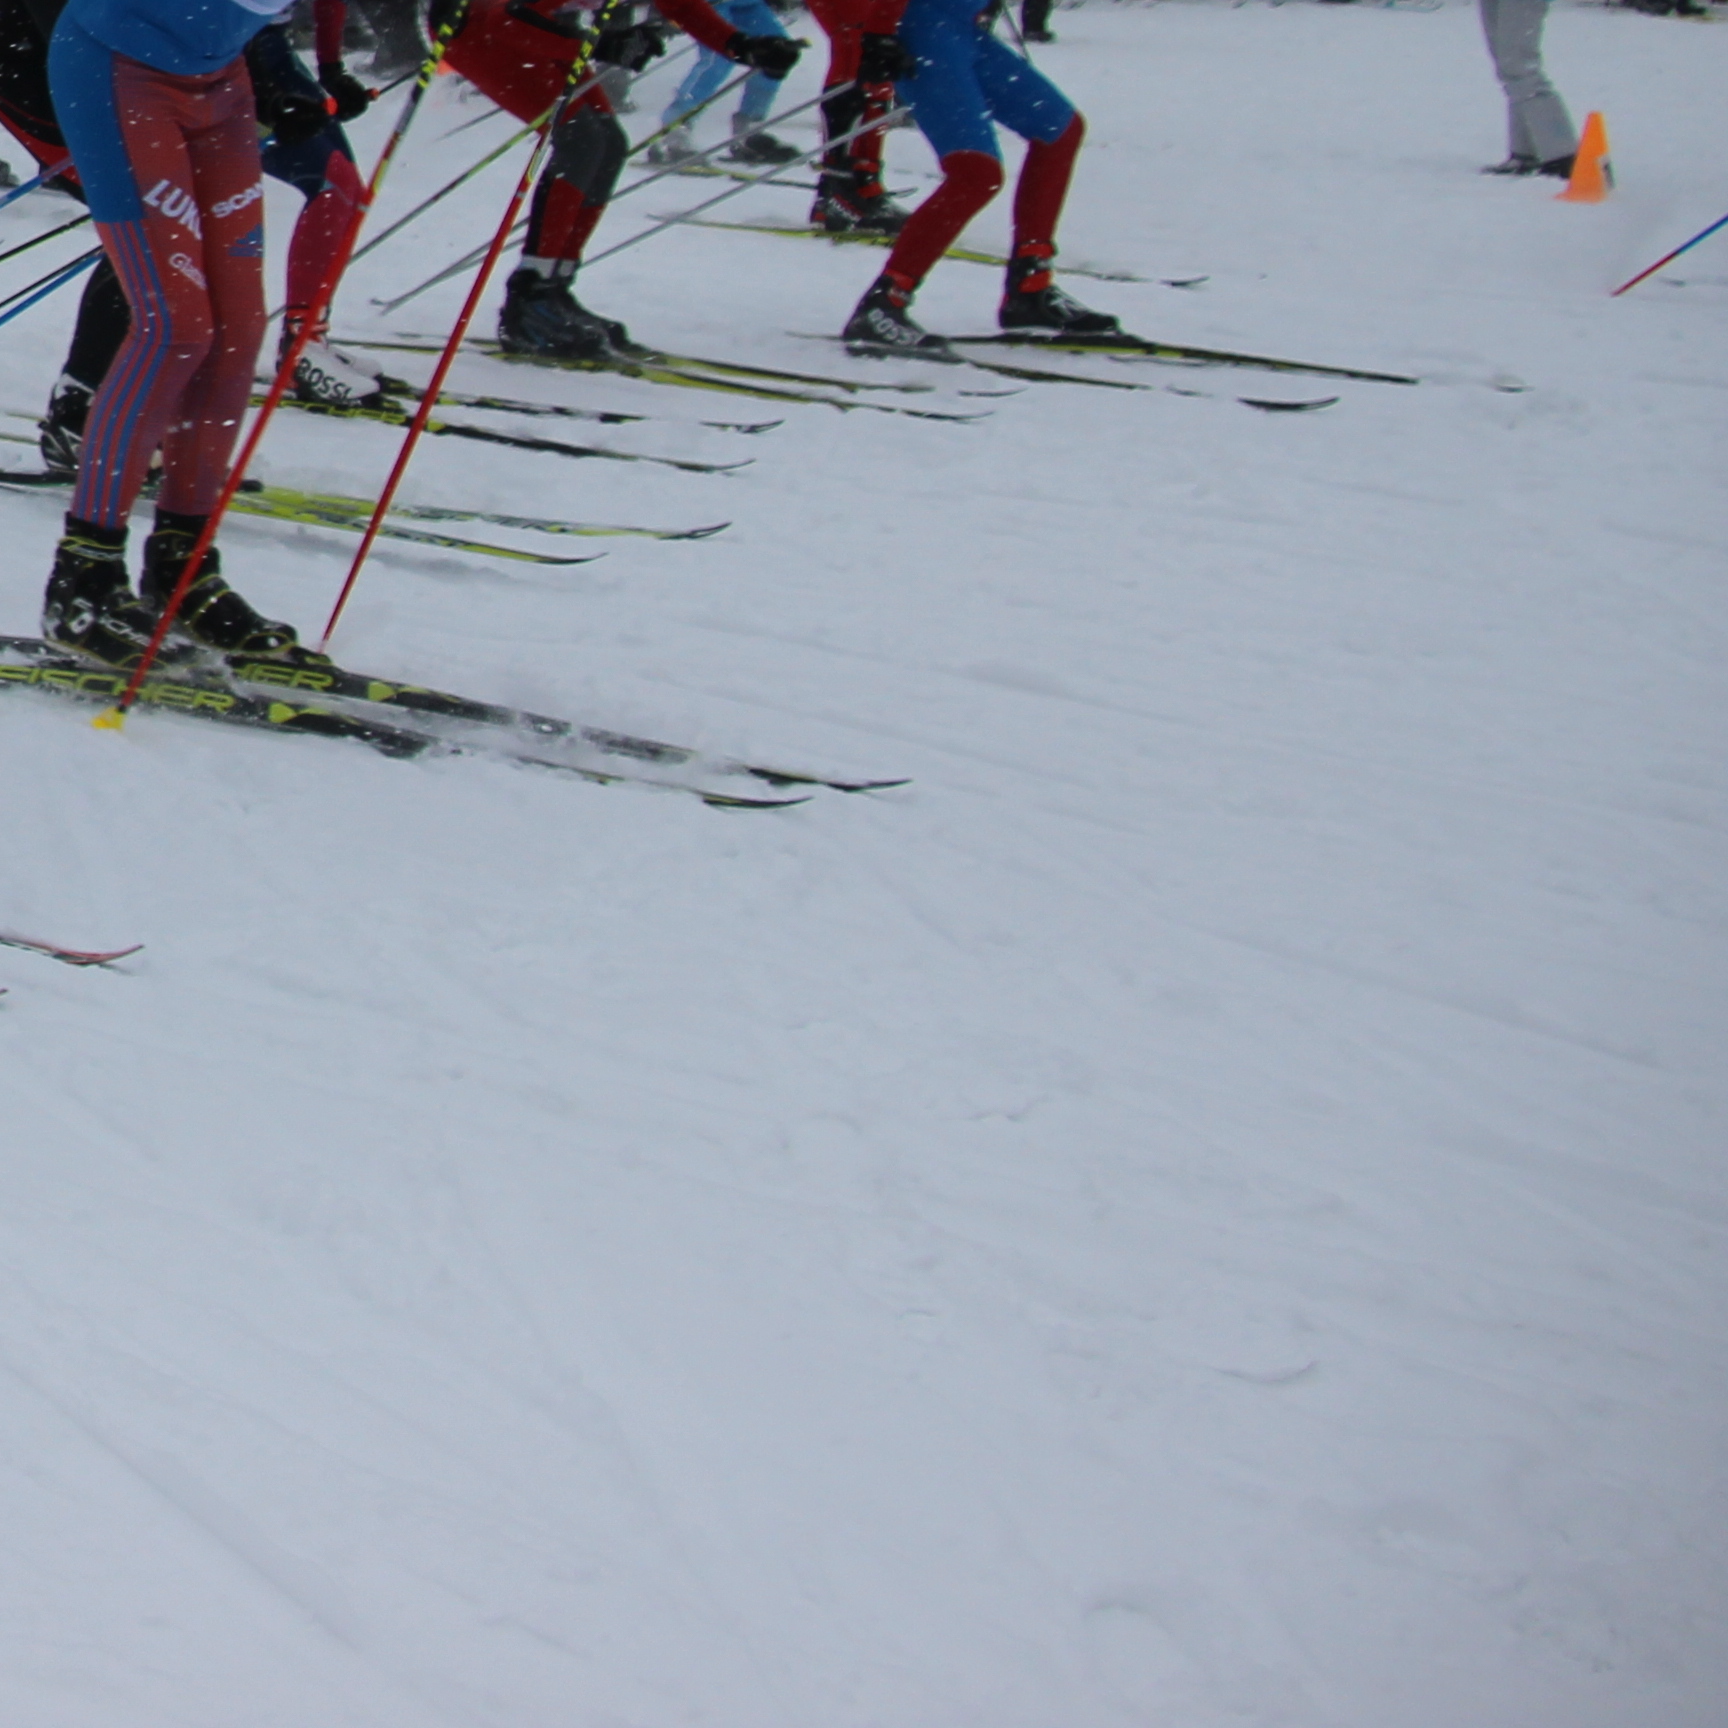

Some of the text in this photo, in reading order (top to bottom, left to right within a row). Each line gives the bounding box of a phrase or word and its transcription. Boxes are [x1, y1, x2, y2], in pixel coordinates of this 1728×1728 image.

[141, 178, 203, 242] LUK
[297, 356, 353, 401] ROSSI
[249, 397, 407, 425] FSCHER
